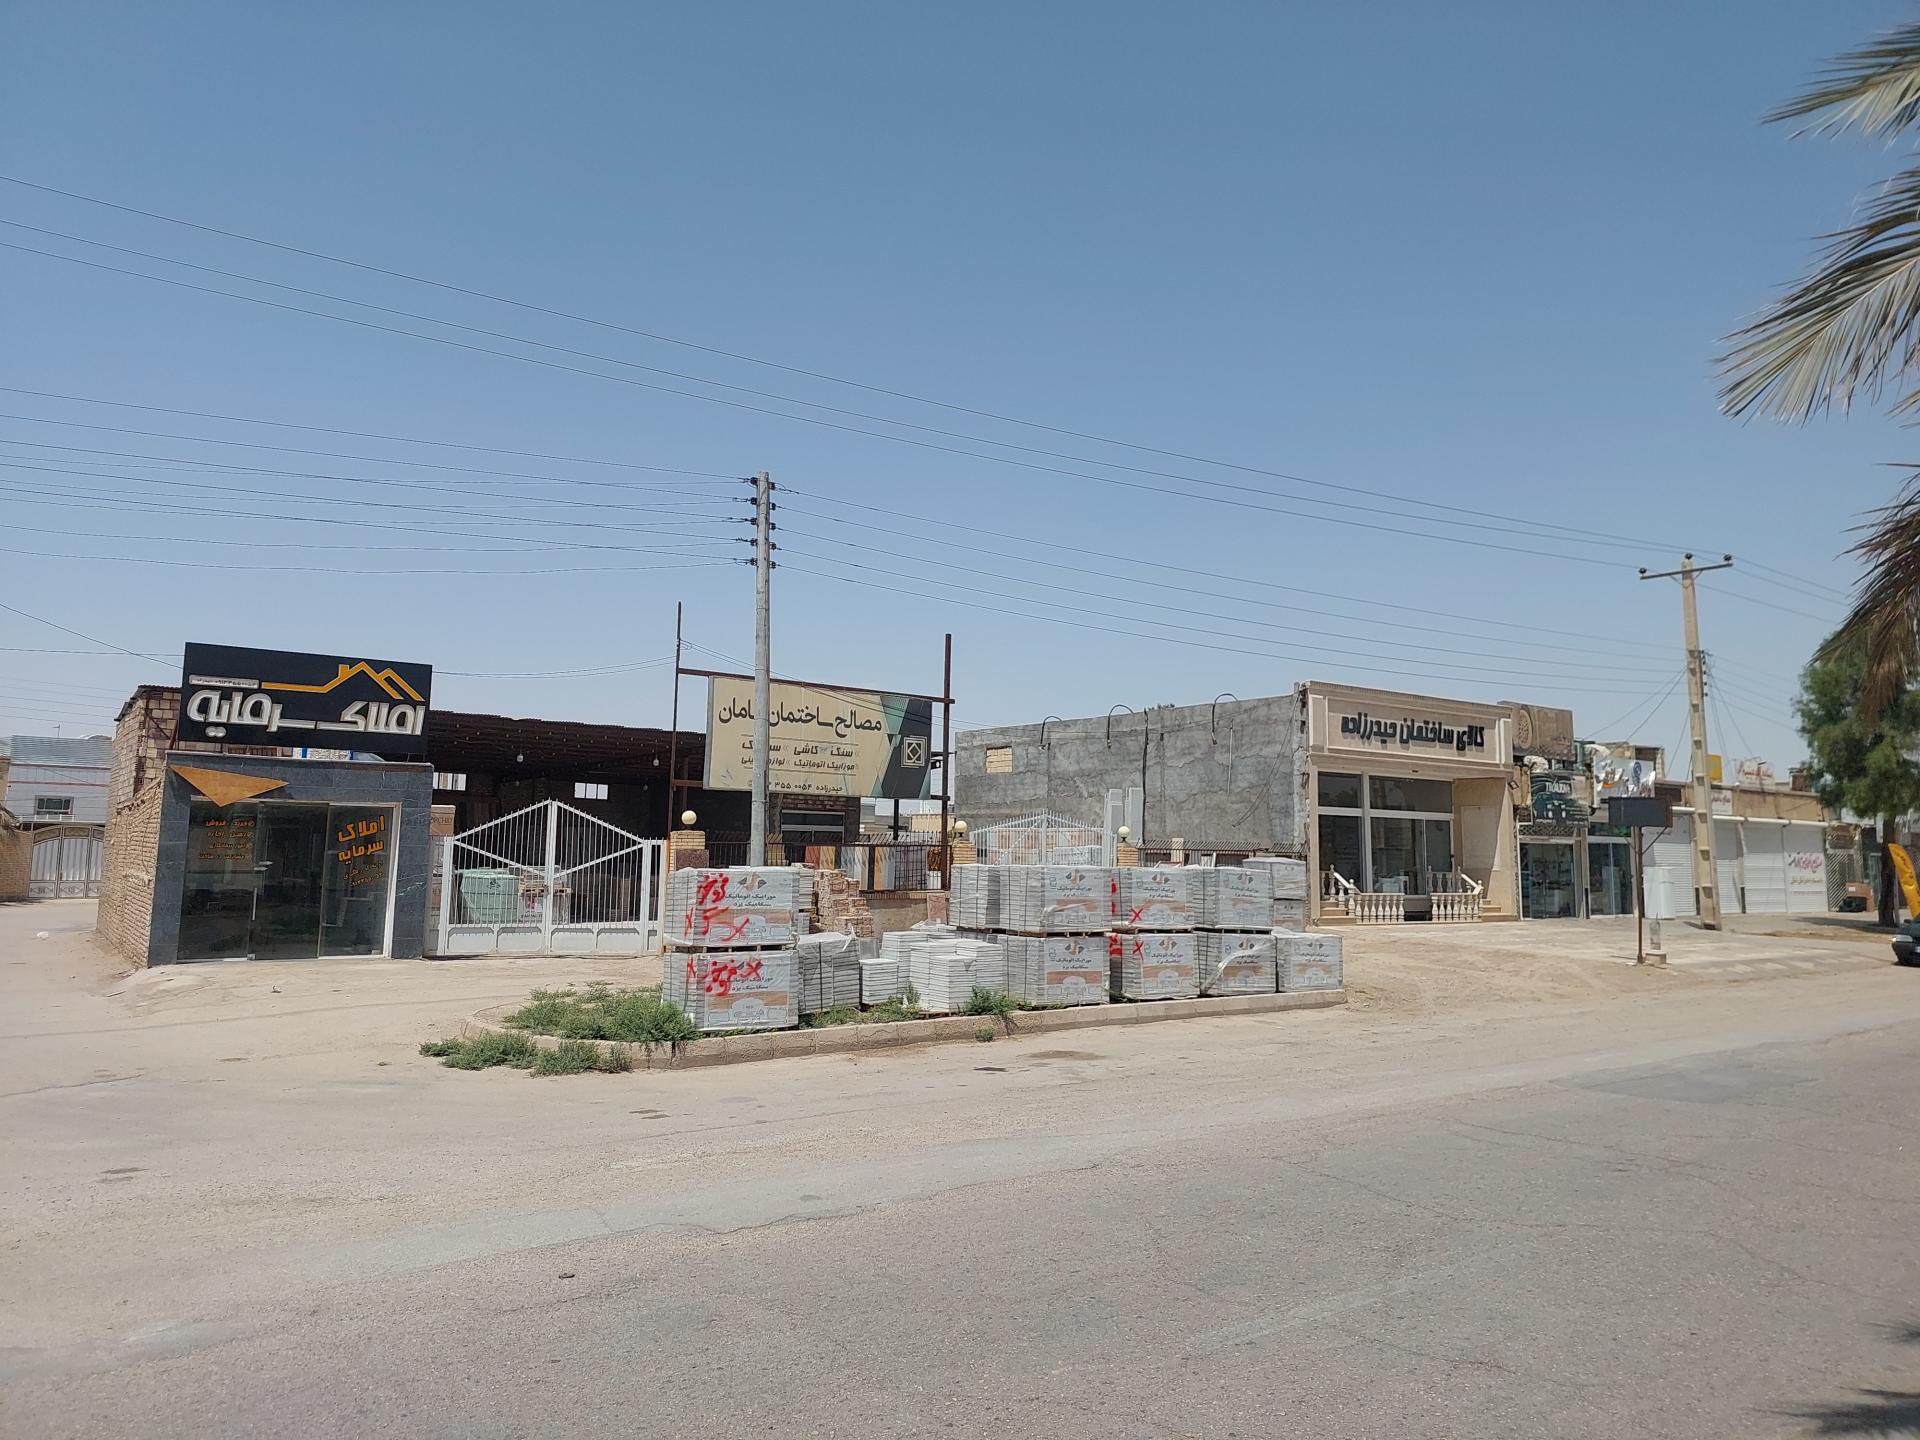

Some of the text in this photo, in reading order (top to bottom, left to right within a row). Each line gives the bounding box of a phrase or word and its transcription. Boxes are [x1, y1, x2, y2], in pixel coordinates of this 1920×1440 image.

[187, 689, 426, 738] املاک سرمایه
[718, 697, 882, 739] مصالح ساختمان امان
[1340, 711, 1485, 751] کالای ساختمان حیدرزاده
[793, 740, 819, 756] کاشی
[830, 744, 854, 758] سنگ
[815, 783, 843, 794] حیدرزاده
[338, 815, 385, 842] املاک
[338, 840, 385, 865] سرمایه
